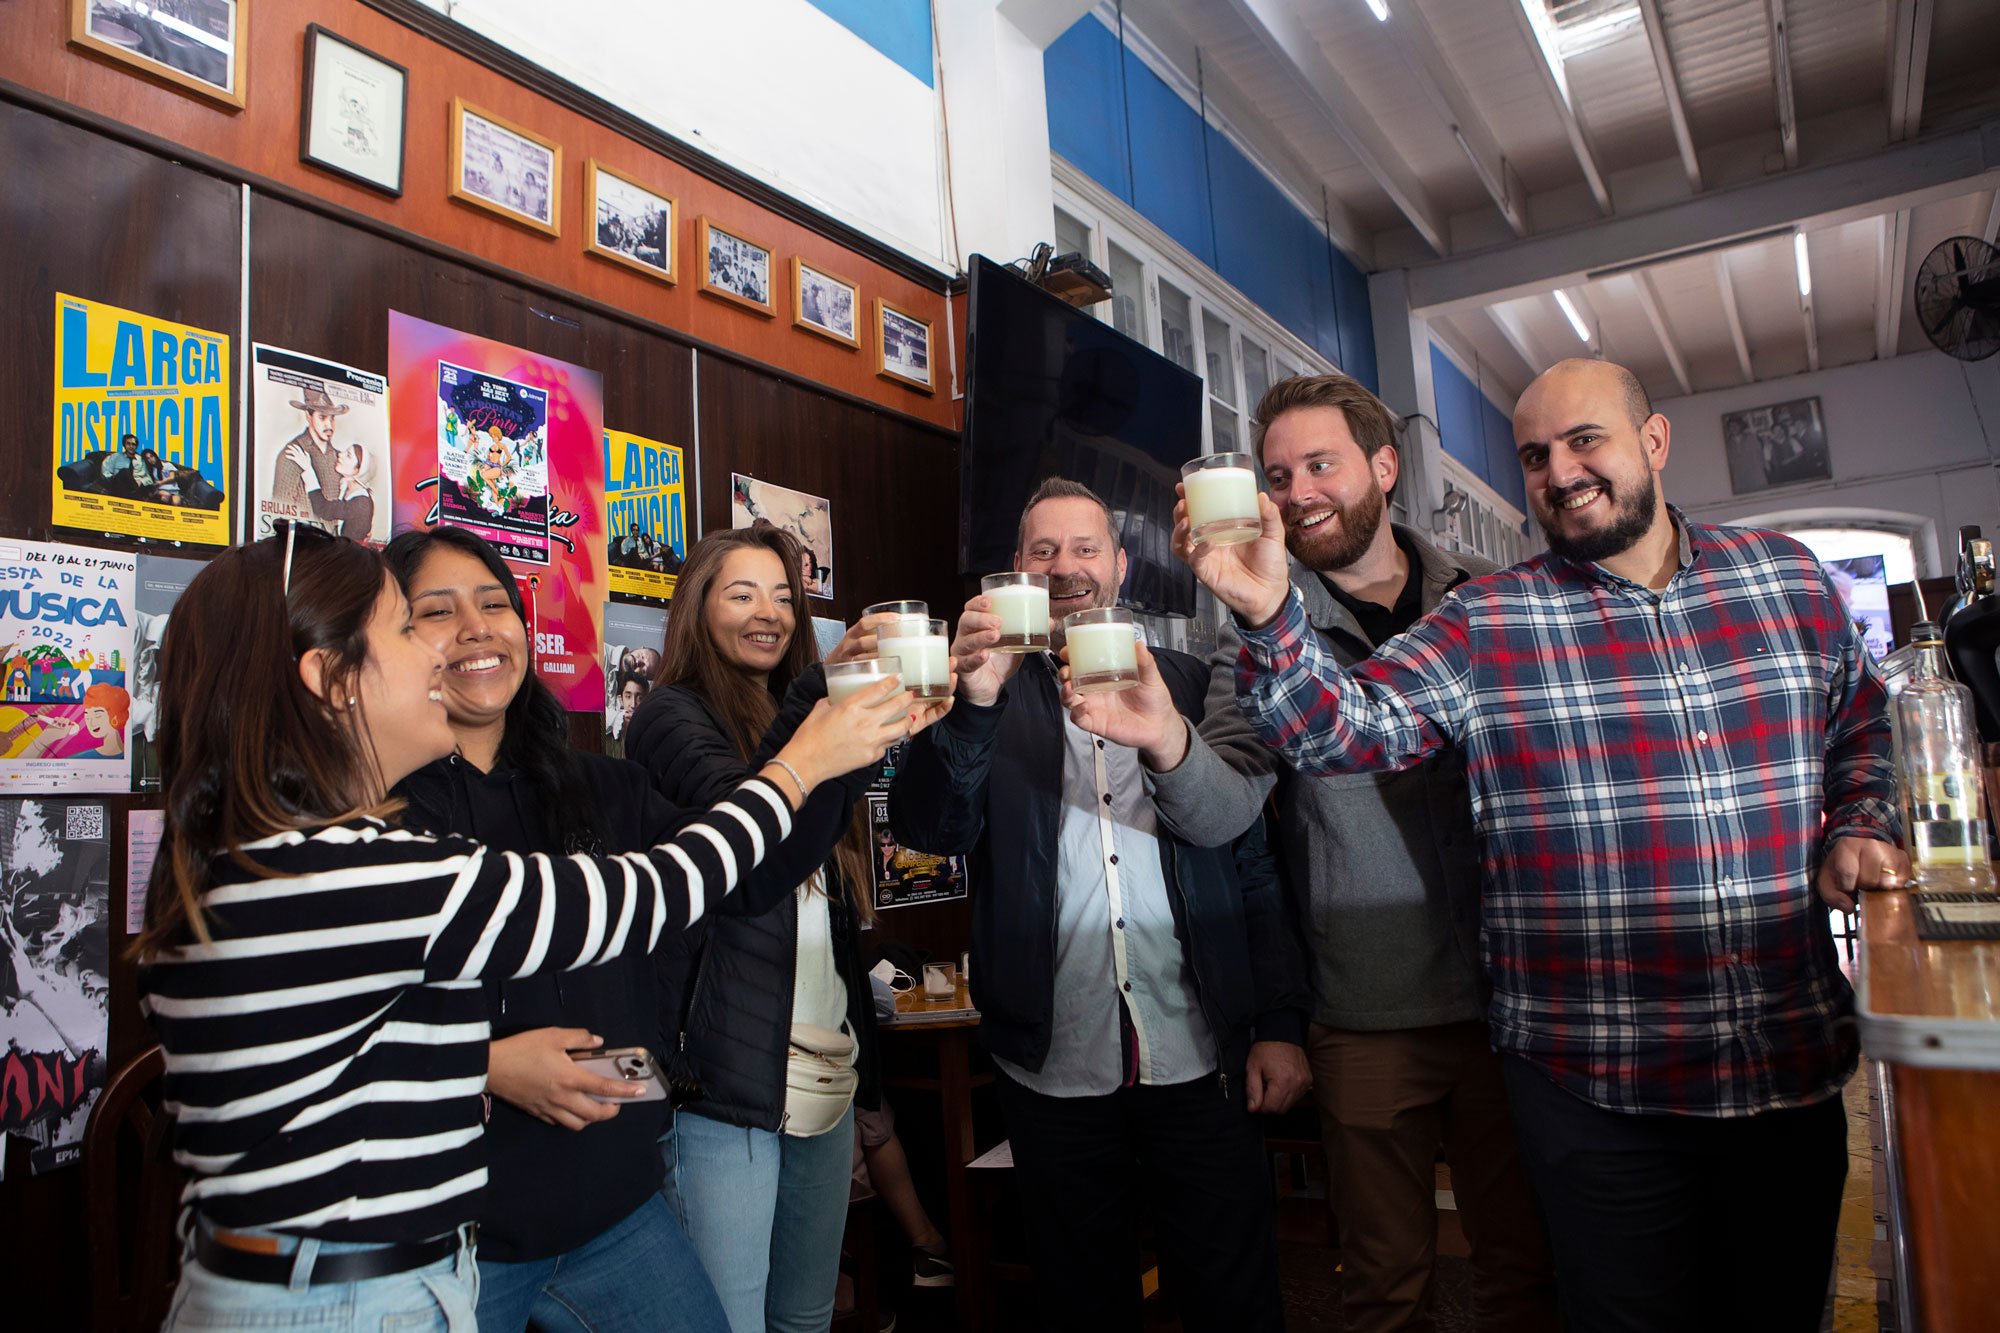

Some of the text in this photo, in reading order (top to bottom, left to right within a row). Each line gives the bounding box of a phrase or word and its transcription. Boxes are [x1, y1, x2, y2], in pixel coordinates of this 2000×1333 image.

[62, 306, 221, 388] LARGA
[346, 370, 382, 388] Proscenio
[468, 406, 518, 437] Party
[61, 396, 224, 493] DISTANCIA
[603, 437, 680, 492] LARGA
[261, 500, 310, 519] BRUJAS en
[607, 492, 685, 560] ISTANCIA
[26, 552, 47, 562] DEL
[52, 554, 65, 565] 18
[66, 556, 81, 566] AL
[99, 560, 135, 572] JUNIO
[60, 572, 84, 588] DE
[97, 575, 119, 590] LA
[31, 625, 73, 649] 2022
[543, 662, 575, 675] GALLIANI
[876, 807, 888, 817] 01
